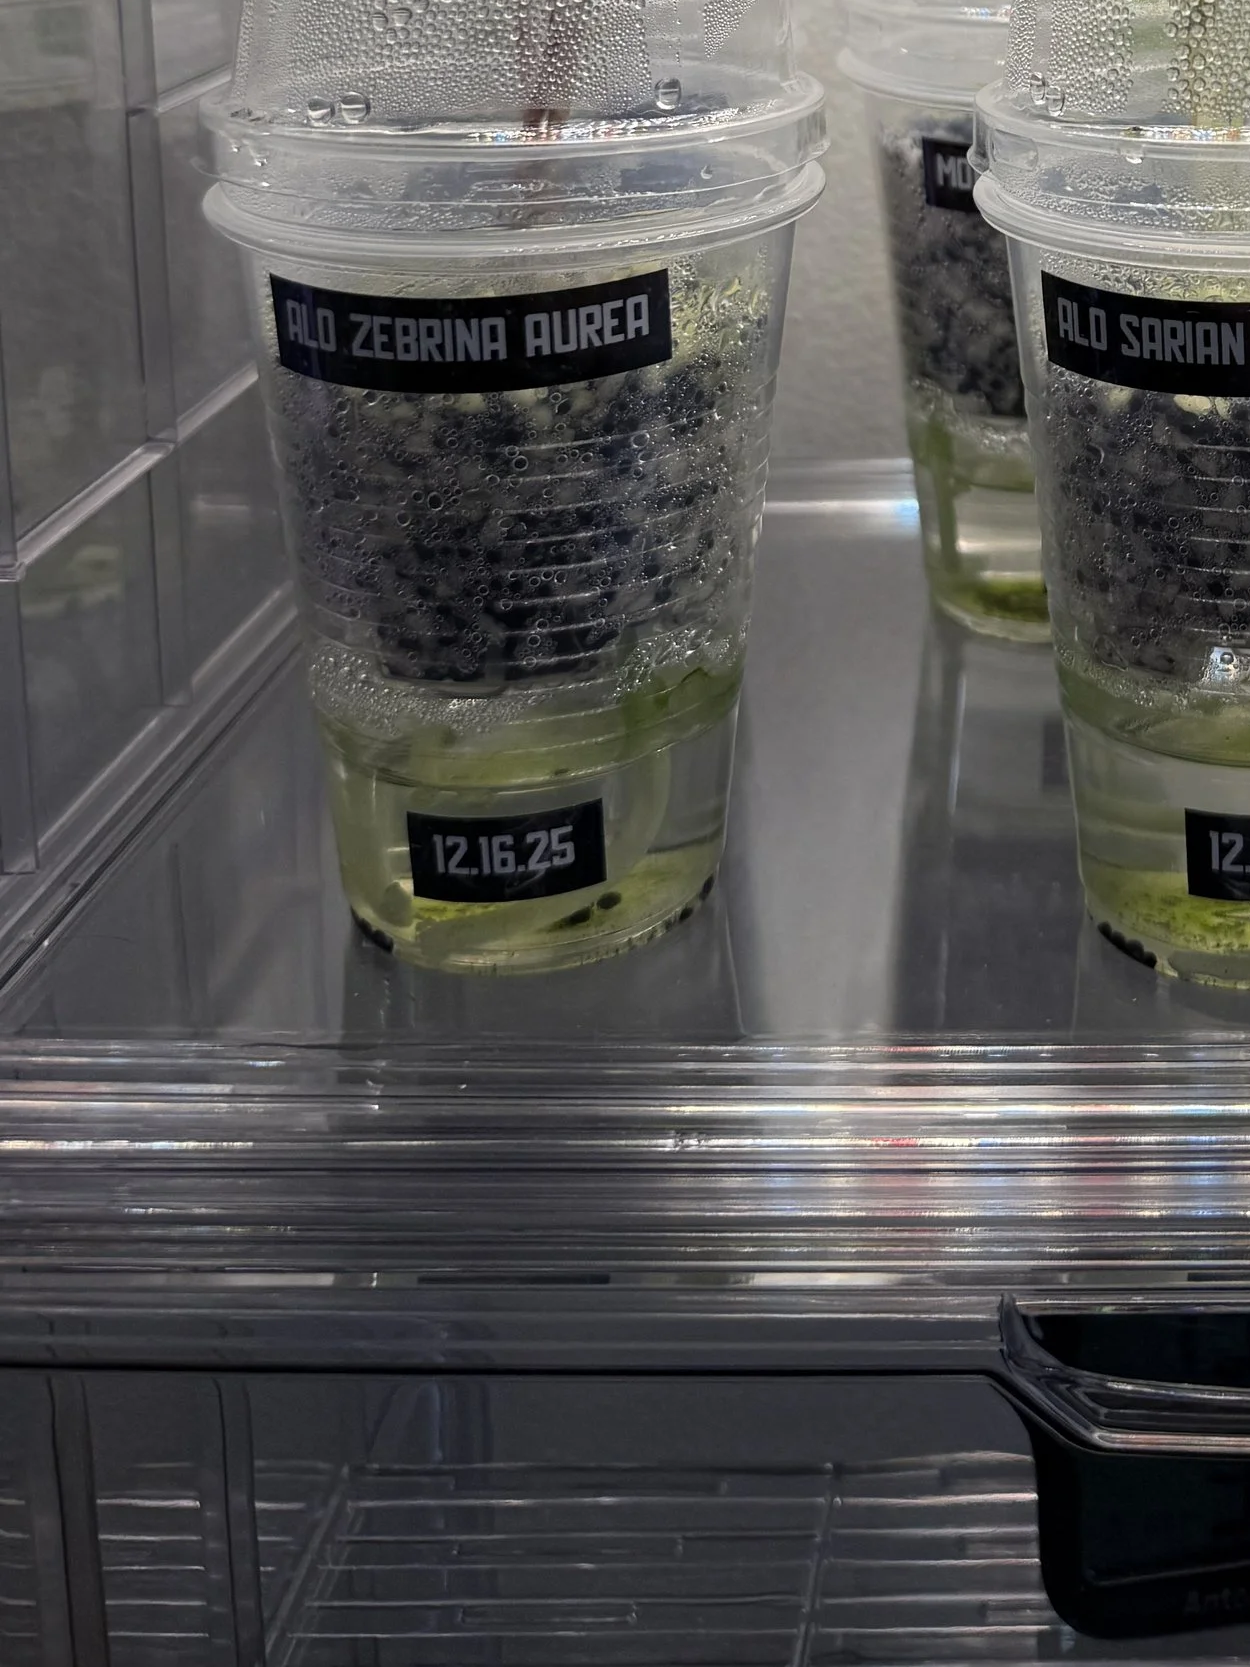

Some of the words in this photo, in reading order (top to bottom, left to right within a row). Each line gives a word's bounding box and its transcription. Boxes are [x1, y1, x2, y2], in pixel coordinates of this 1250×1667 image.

[936, 152, 979, 190] MO
[348, 313, 508, 363] ZEBRINA
[524, 292, 651, 358] AUREA
[1119, 313, 1246, 366] SARIAN
[432, 824, 576, 876] 12.16.25
